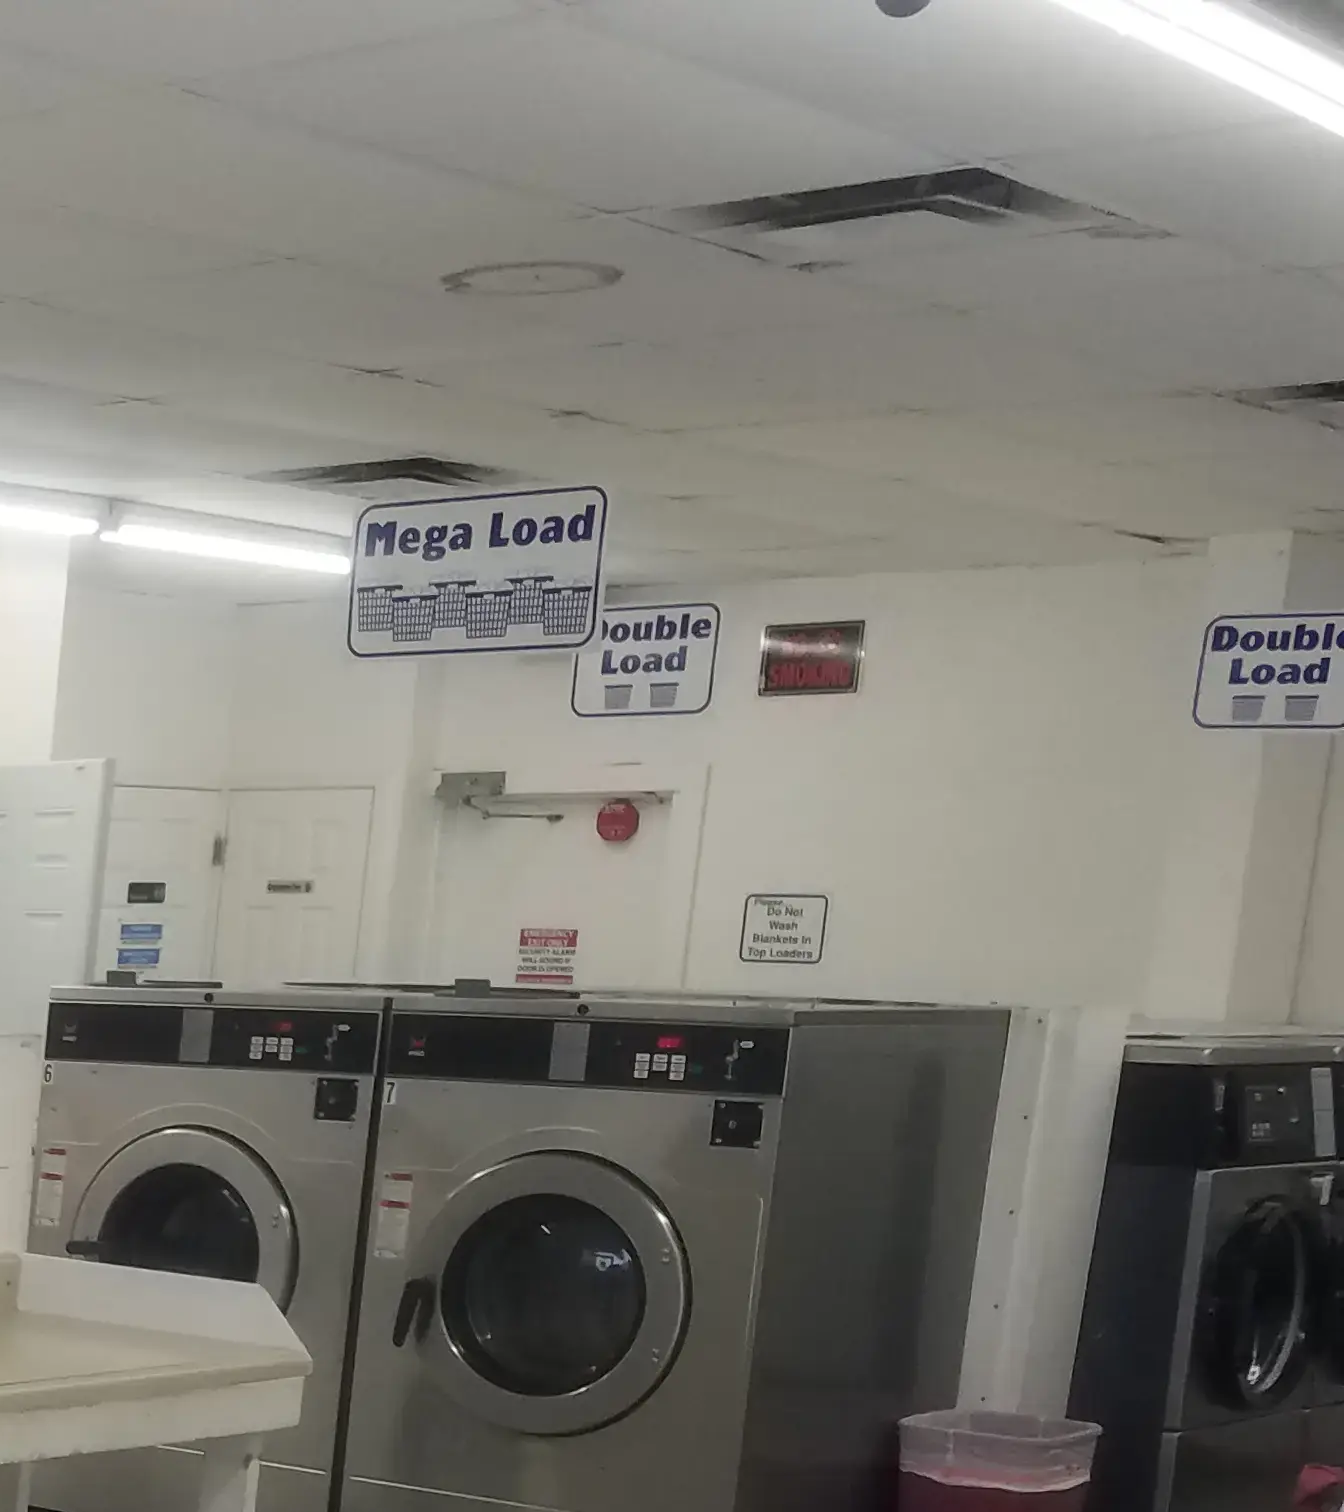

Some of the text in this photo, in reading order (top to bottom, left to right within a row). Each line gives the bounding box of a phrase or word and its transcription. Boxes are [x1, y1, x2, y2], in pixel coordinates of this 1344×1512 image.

[365, 504, 596, 561] Mega Load
[602, 613, 712, 643] ouble
[601, 646, 688, 675] Load
[1229, 657, 1331, 684] Load
[767, 906, 804, 916] Do Not
[769, 920, 798, 930] Wash
[752, 933, 811, 944] Blankets In
[748, 947, 813, 959] Top Loaders
[44, 1064, 52, 1083] 6
[387, 1082, 395, 1104] 7
